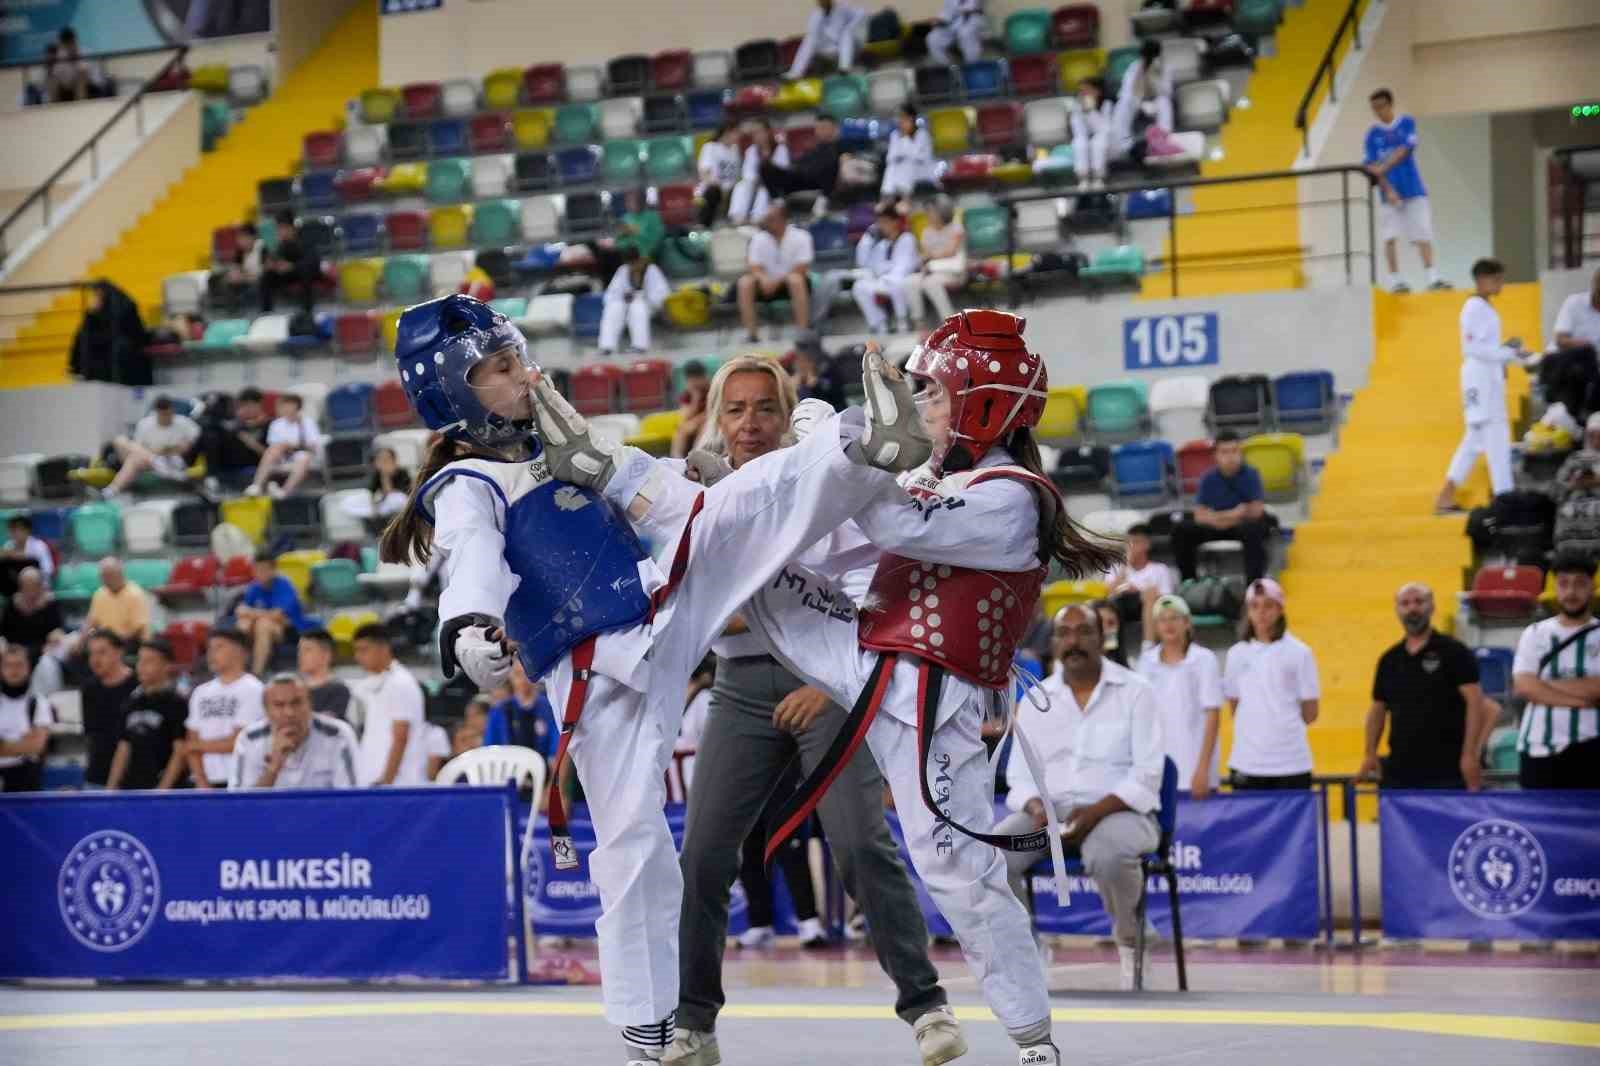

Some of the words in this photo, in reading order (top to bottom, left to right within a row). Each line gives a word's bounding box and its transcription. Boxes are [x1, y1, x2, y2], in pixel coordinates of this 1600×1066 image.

[1131, 315, 1207, 364] 105
[220, 852, 371, 890] BALIKESİR
[165, 896, 232, 925] GENÇLİK
[235, 899, 257, 920] VE
[259, 899, 302, 921] SPOR
[305, 895, 320, 920] İL
[323, 894, 430, 920] MÜDÜRLÜĞÜ
